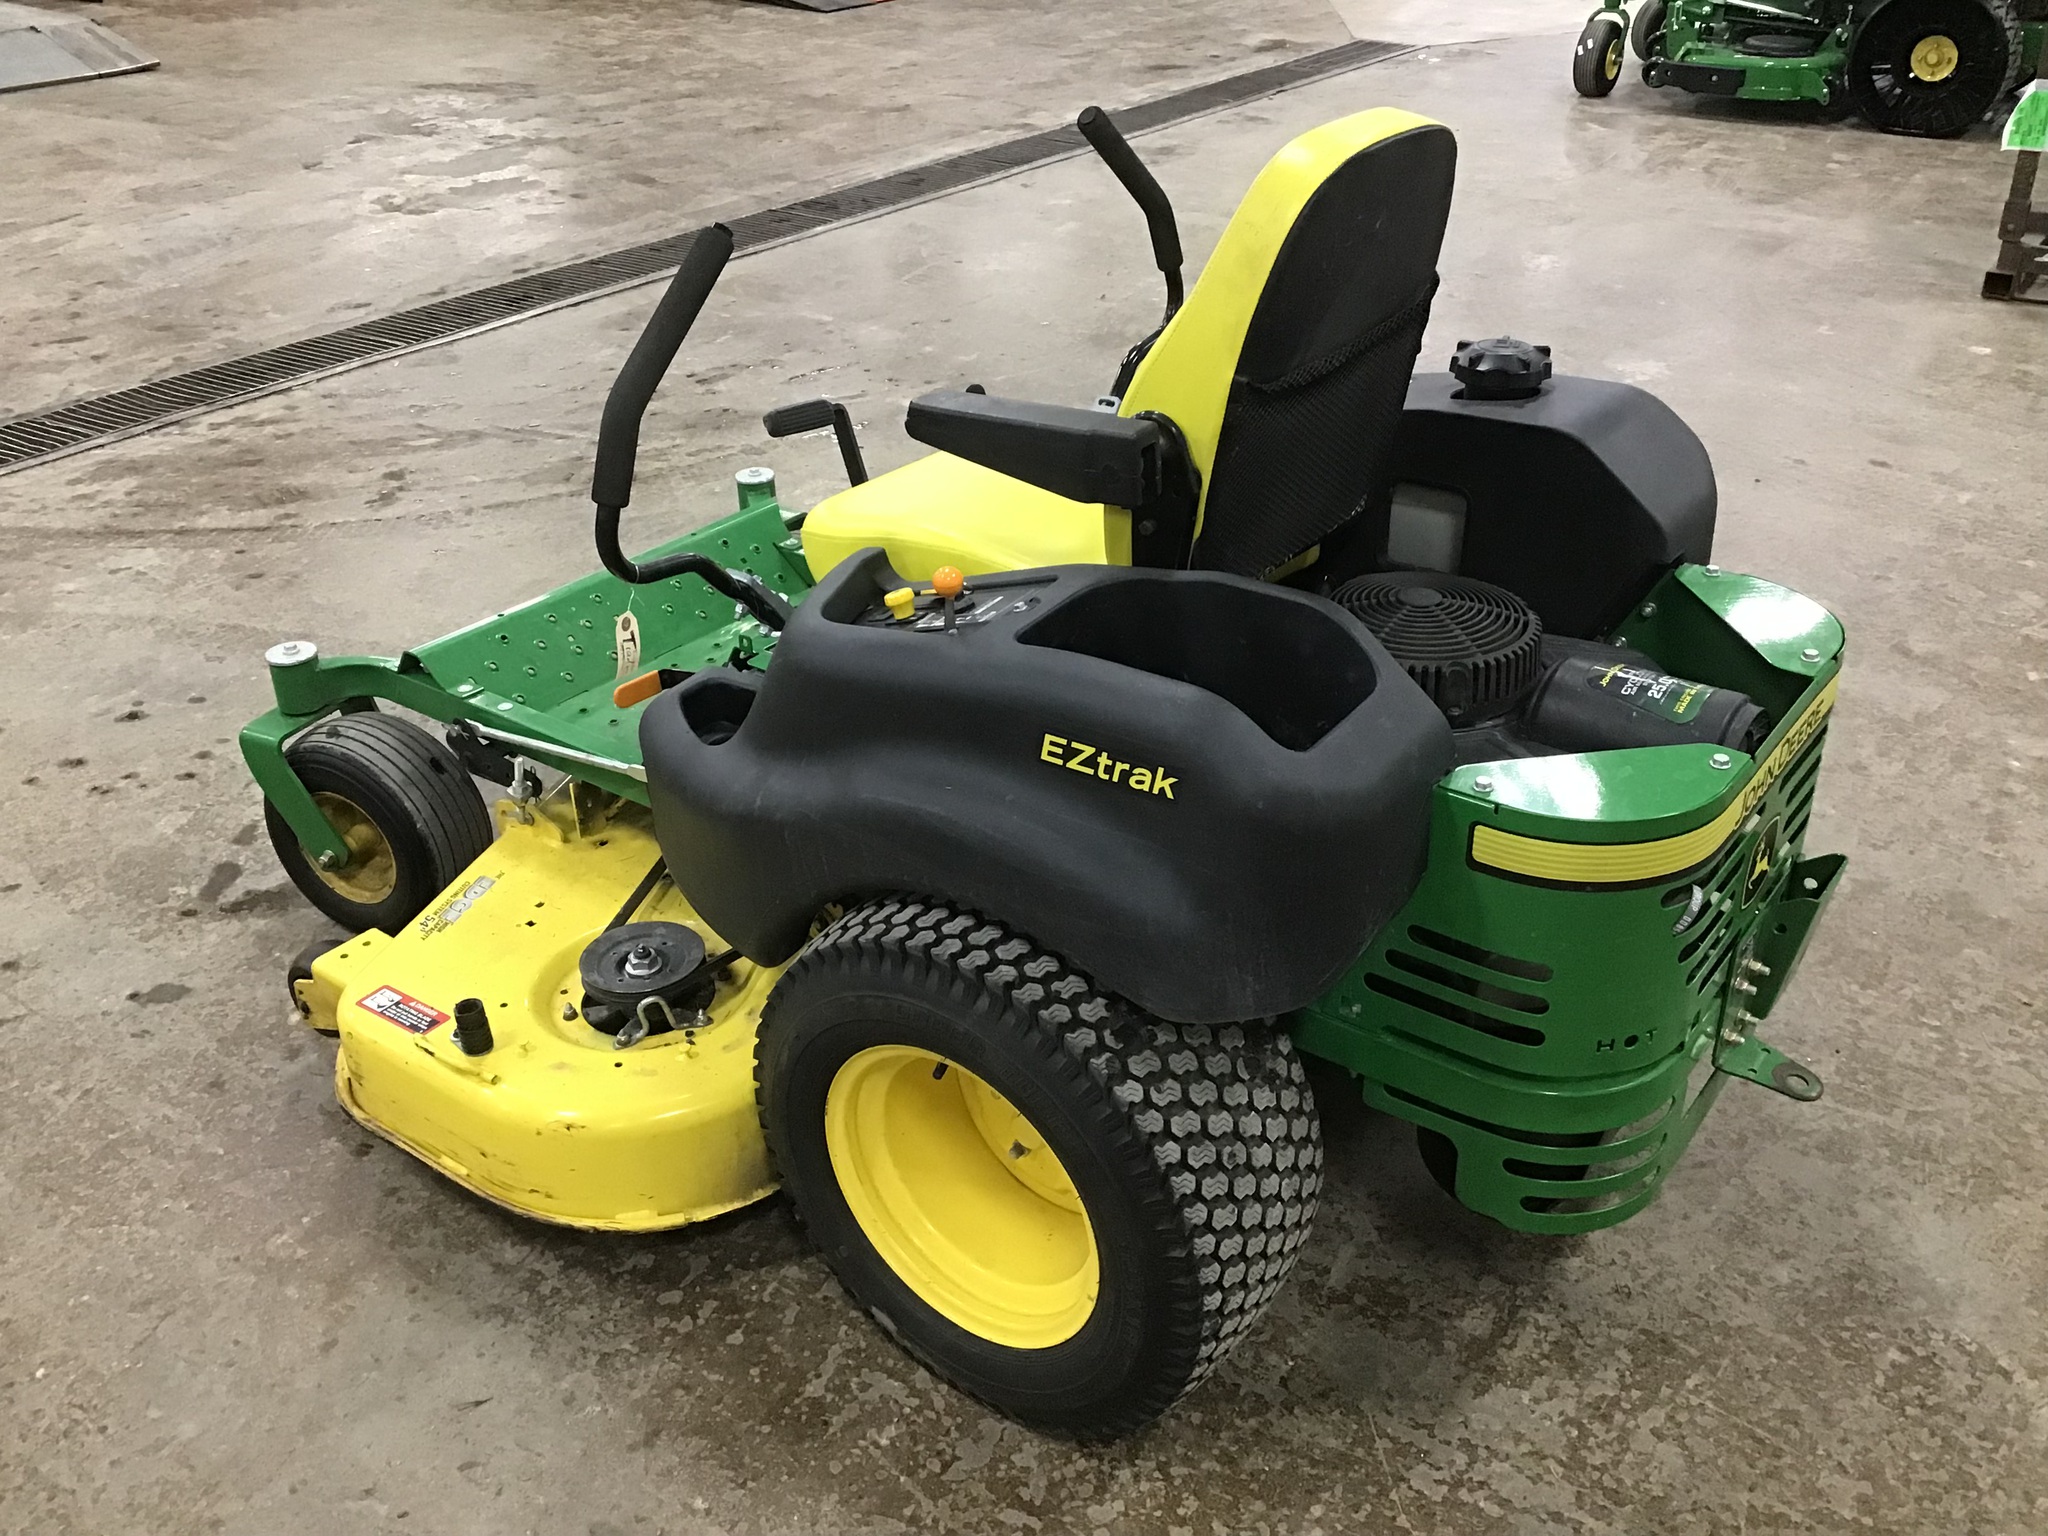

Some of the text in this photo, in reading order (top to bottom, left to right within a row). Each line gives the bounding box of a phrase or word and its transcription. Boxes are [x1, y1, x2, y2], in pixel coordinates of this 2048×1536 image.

[1040, 733, 1179, 800] EZtrak
[1734, 698, 1825, 830] JOHN DEERE
[432, 880, 471, 916] CUTTING SYSTEM
[437, 874, 497, 923] EDGE
[420, 918, 444, 941] CAPACITY
[1596, 1027, 1658, 1053] HOT
